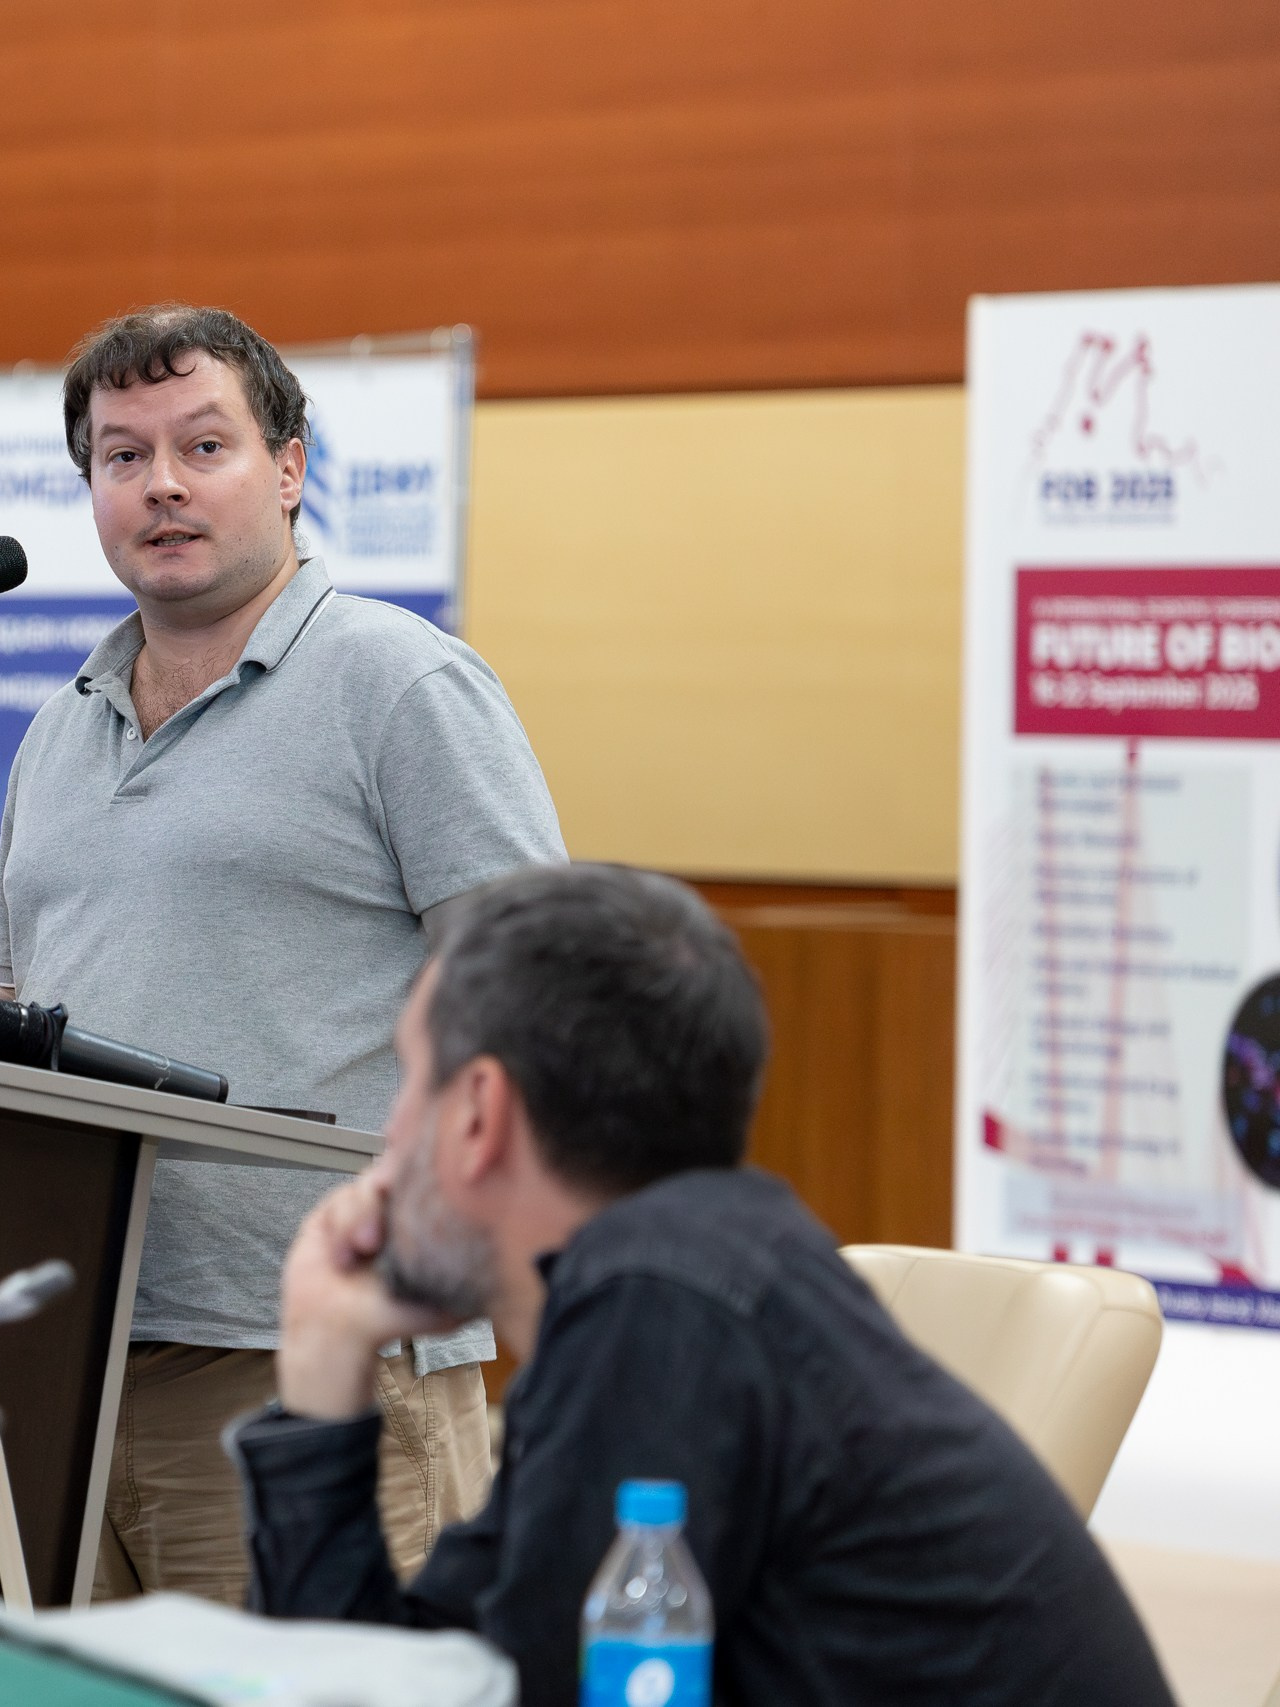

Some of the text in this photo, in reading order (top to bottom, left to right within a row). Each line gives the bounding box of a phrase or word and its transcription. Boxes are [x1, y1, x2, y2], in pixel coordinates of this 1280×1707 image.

[1029, 621, 1280, 673] FUTURE OF BIO
[1087, 674, 1202, 715] September
